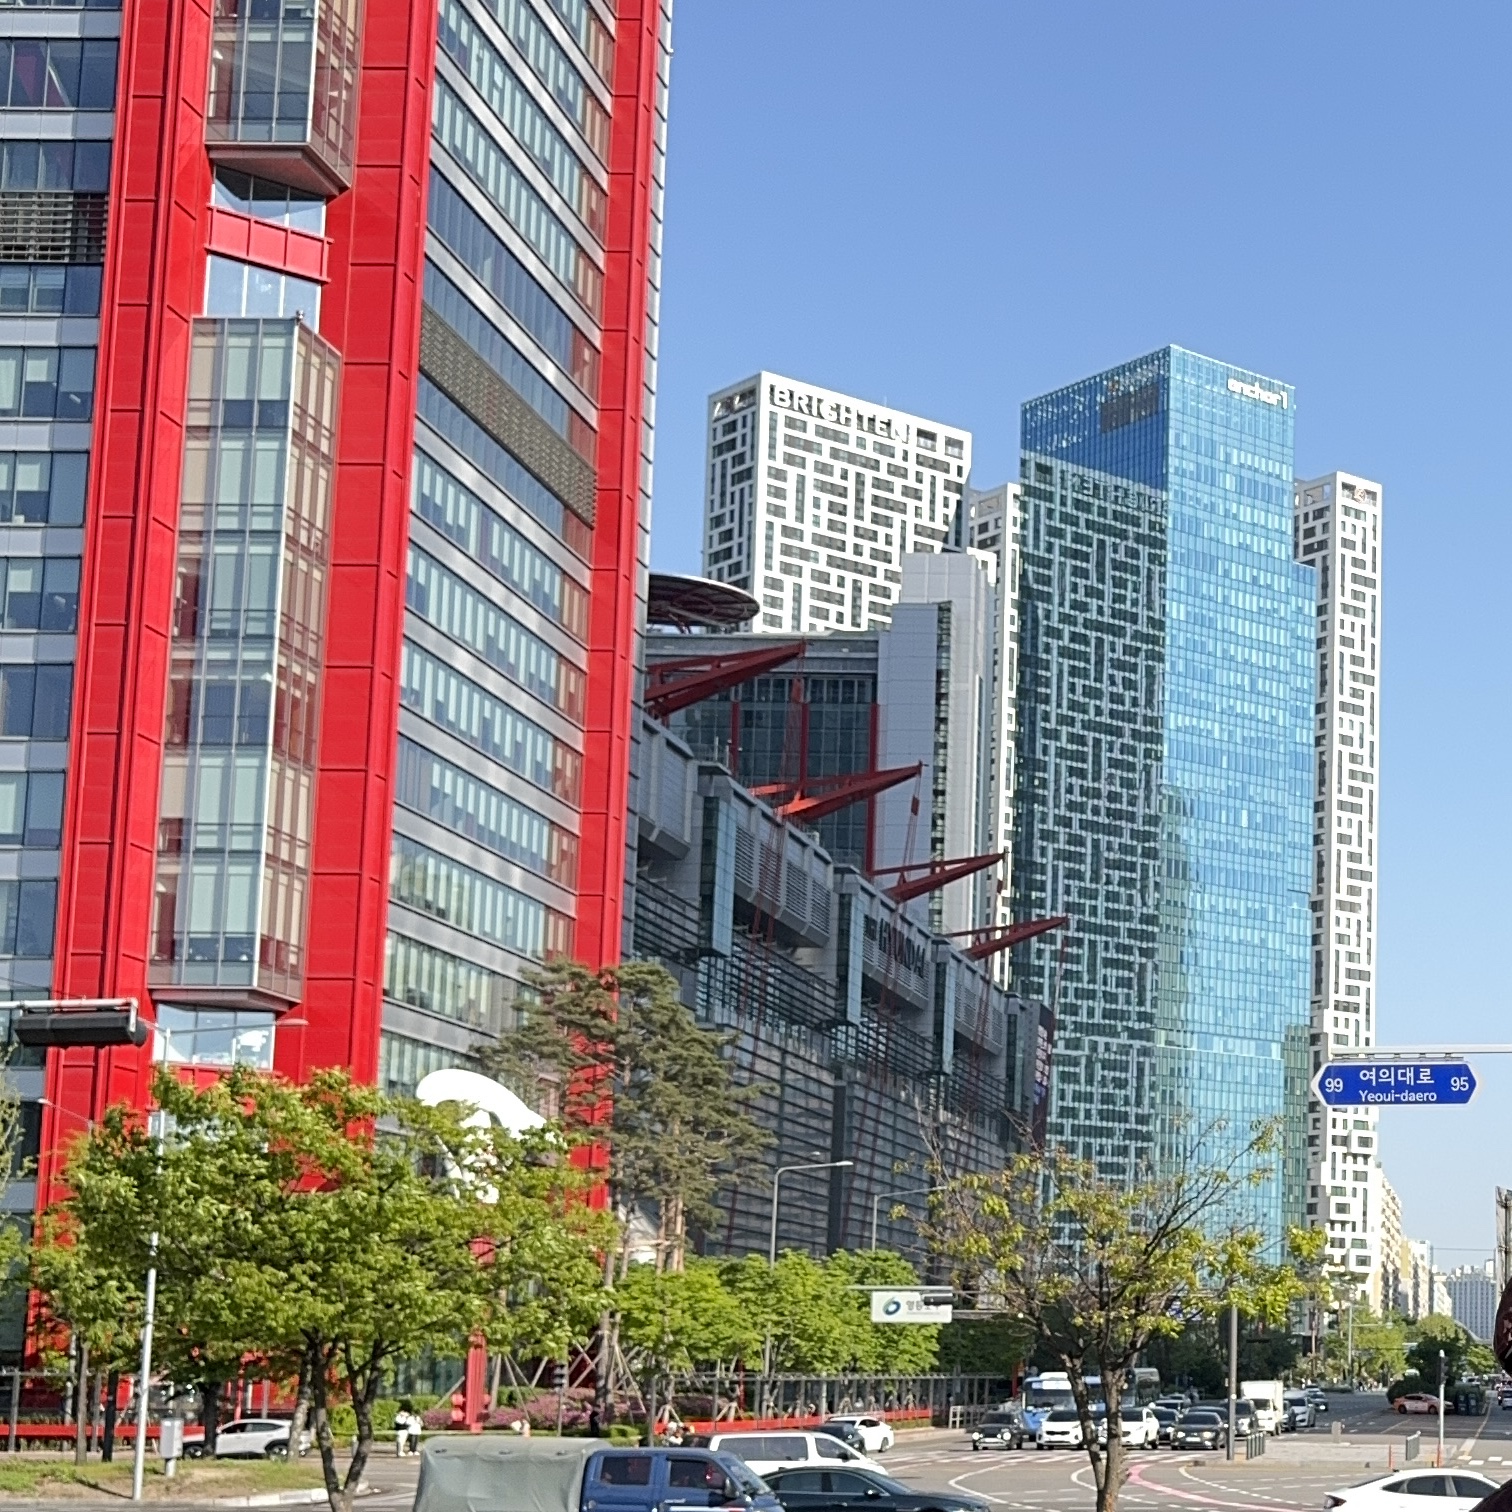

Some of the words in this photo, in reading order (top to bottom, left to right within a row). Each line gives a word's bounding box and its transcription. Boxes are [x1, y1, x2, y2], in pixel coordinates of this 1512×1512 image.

[773, 386, 909, 443] BRIGHTEN
[1359, 1066, 1435, 1086] 여의대로
[1450, 1076, 1470, 1091] 95
[1324, 1078, 1344, 1093] 99
[1359, 1089, 1437, 1102] Yeoui-daero
